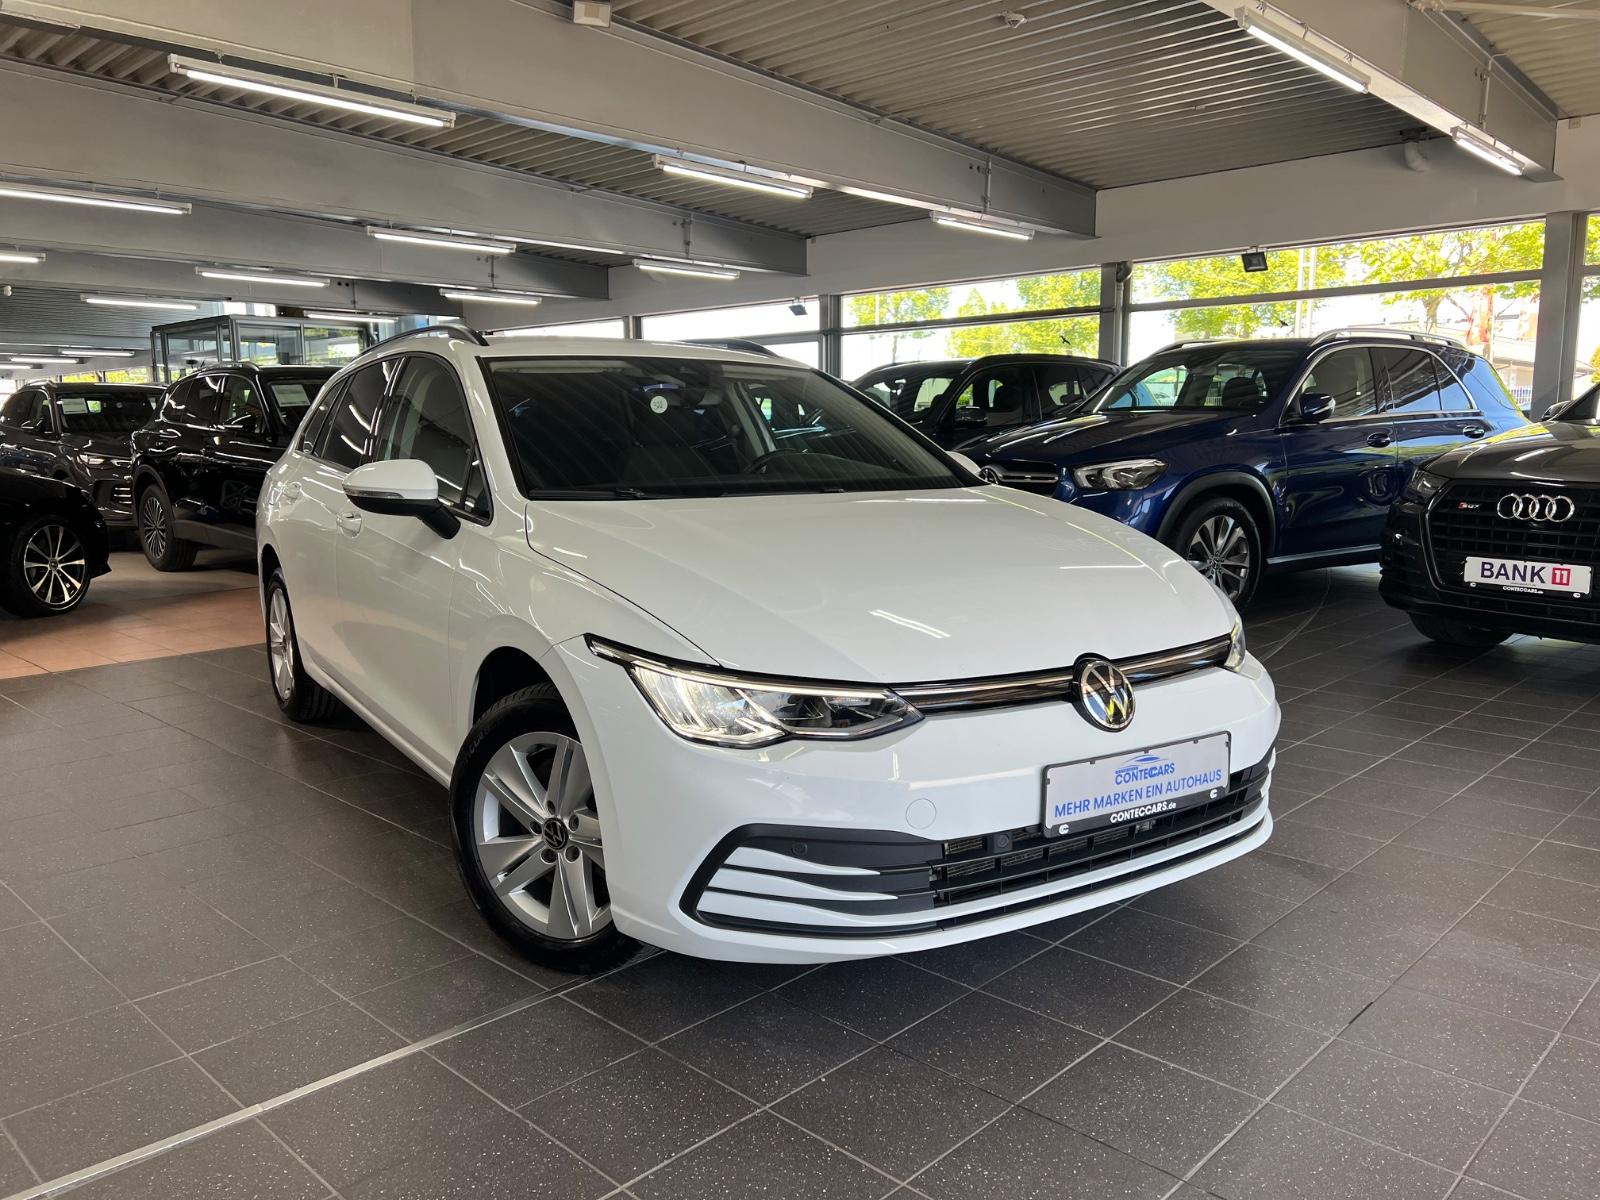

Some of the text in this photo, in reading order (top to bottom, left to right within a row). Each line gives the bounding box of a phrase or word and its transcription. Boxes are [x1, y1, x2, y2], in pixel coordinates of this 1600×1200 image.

[1480, 561, 1569, 585] BANK 11
[1115, 762, 1175, 785] CONTECCARS
[1055, 769, 1222, 818] MEHR MARKEN EIN AUTOHAUS
[1110, 801, 1177, 823] CONTECCARS.de
